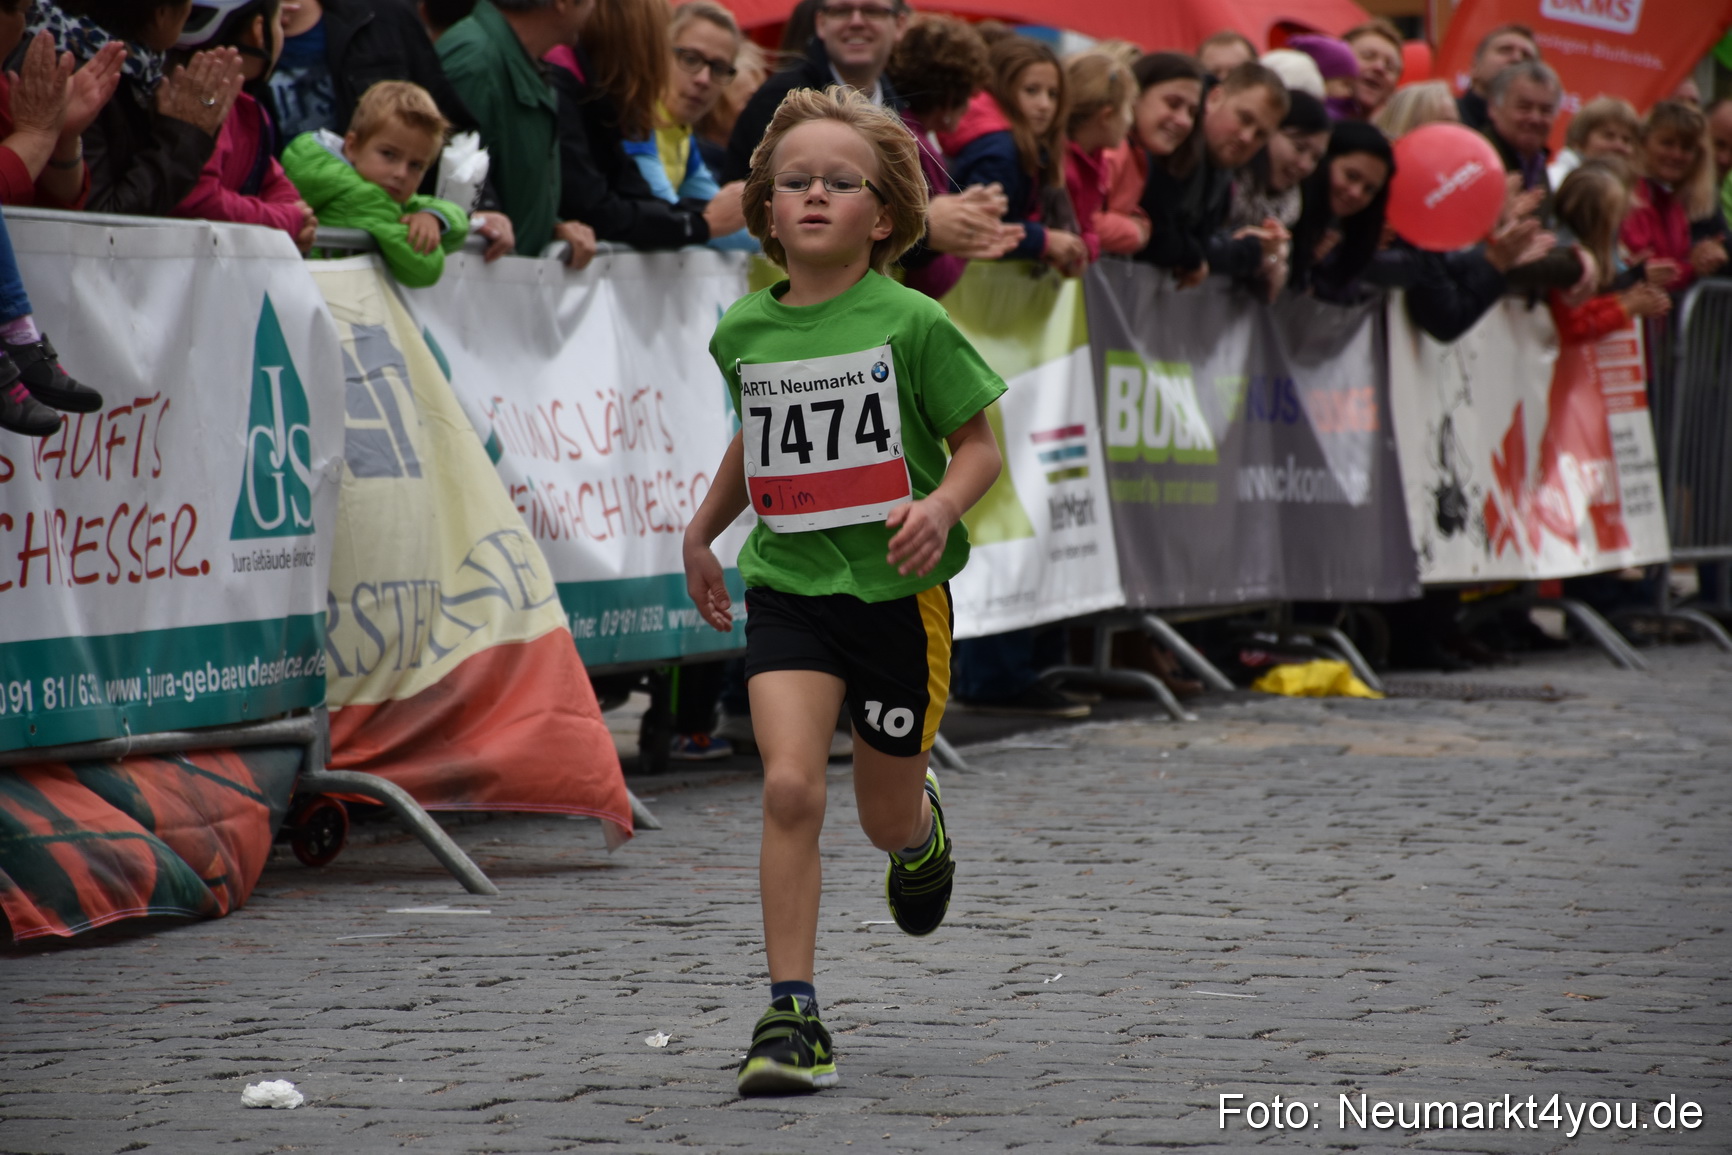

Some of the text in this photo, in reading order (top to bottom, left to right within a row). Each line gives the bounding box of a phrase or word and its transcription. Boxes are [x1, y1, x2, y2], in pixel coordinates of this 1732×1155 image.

[781, 371, 865, 394] Neumarkt
[749, 392, 890, 467] 7474
[765, 479, 816, 510] Tim
[232, 552, 252, 573] Jura
[865, 701, 914, 738] 10
